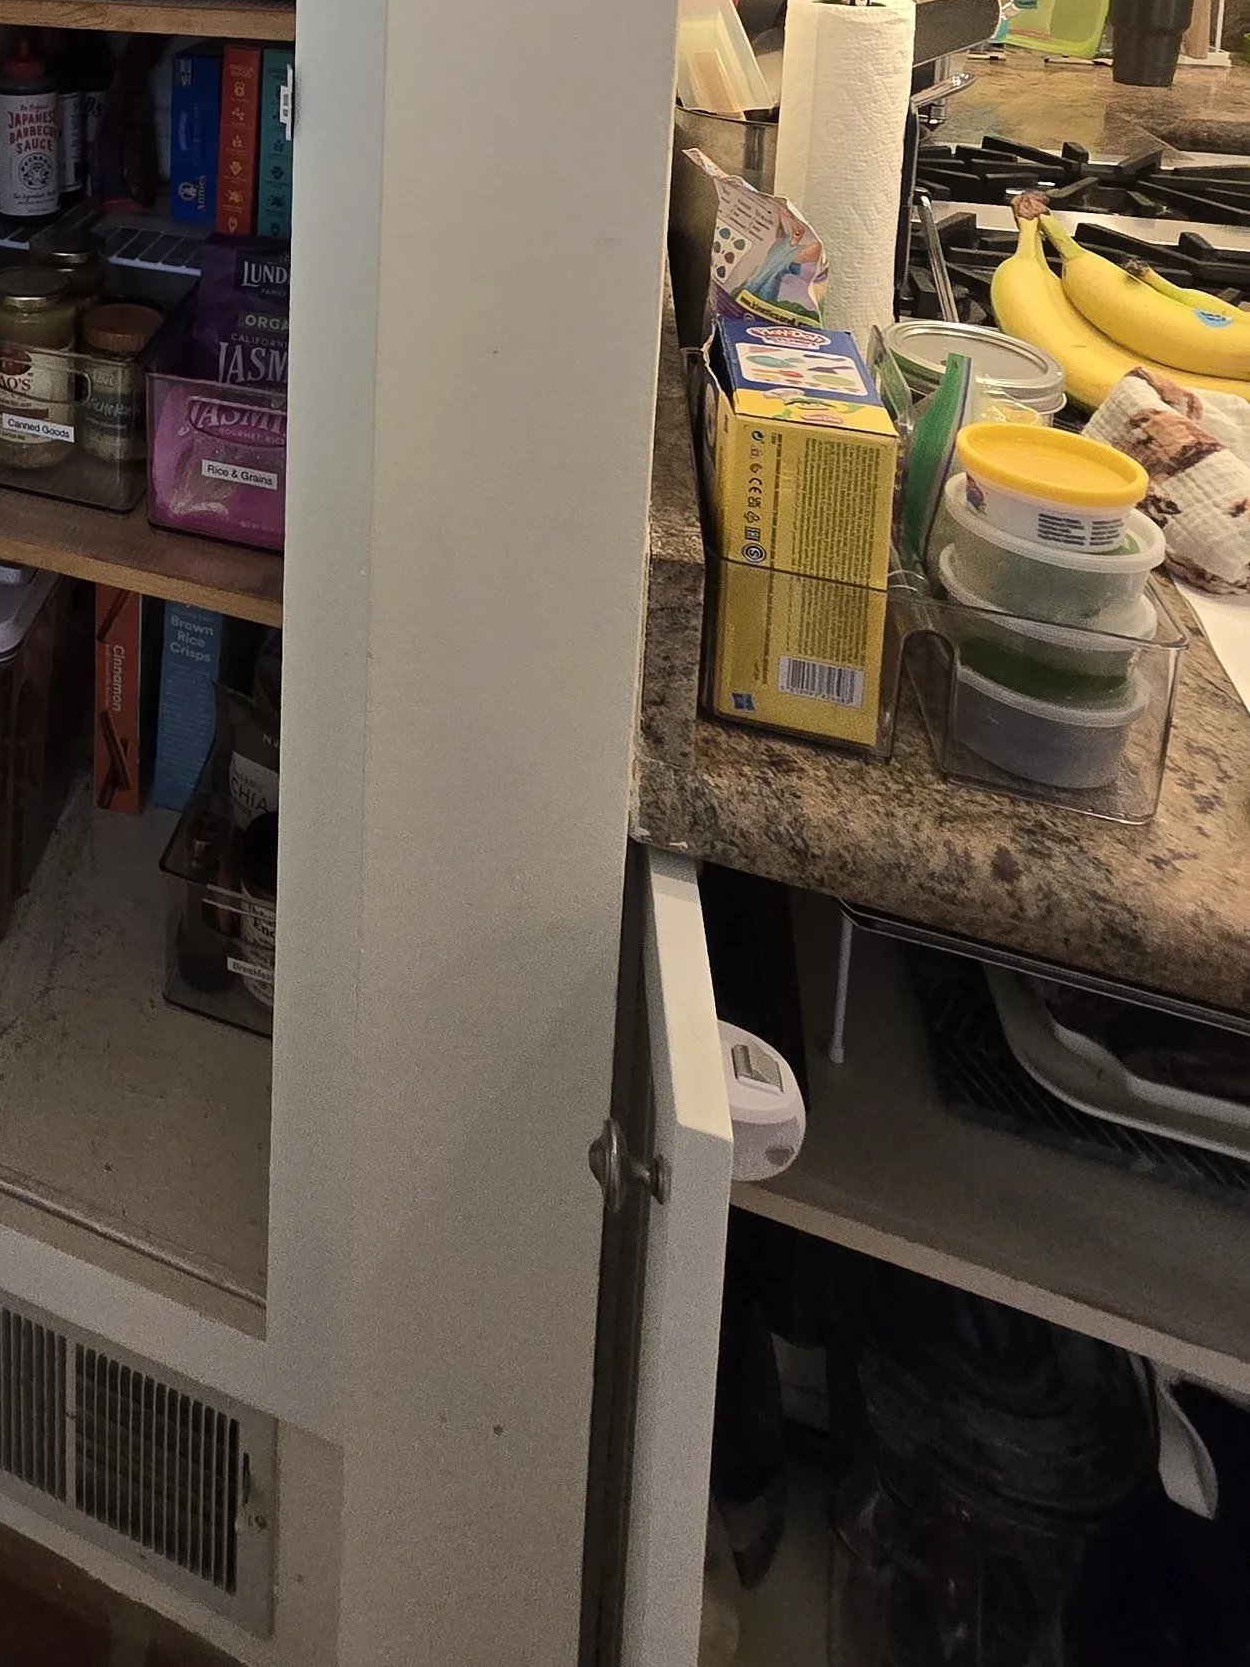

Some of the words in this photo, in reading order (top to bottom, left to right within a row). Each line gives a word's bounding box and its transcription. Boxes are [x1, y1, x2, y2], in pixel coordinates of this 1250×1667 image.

[8, 125, 58, 145] BARBECU
[16, 138, 53, 155] SAUCE
[241, 260, 288, 288] LUND
[244, 314, 288, 332] ORGA
[231, 333, 287, 348] CALIFORNI
[219, 341, 287, 384] JASM
[7, 417, 41, 433] Canned
[42, 425, 71, 439] Goods
[207, 464, 229, 478] Rice
[231, 470, 239, 479] &
[240, 471, 273, 486] Grains
[171, 615, 214, 637] Brown
[177, 630, 206, 647] Rice
[169, 642, 211, 664] Crisps
[112, 644, 125, 712] Cinnamon
[230, 777, 268, 814] CHIA
[232, 962, 274, 982] Breakfas
